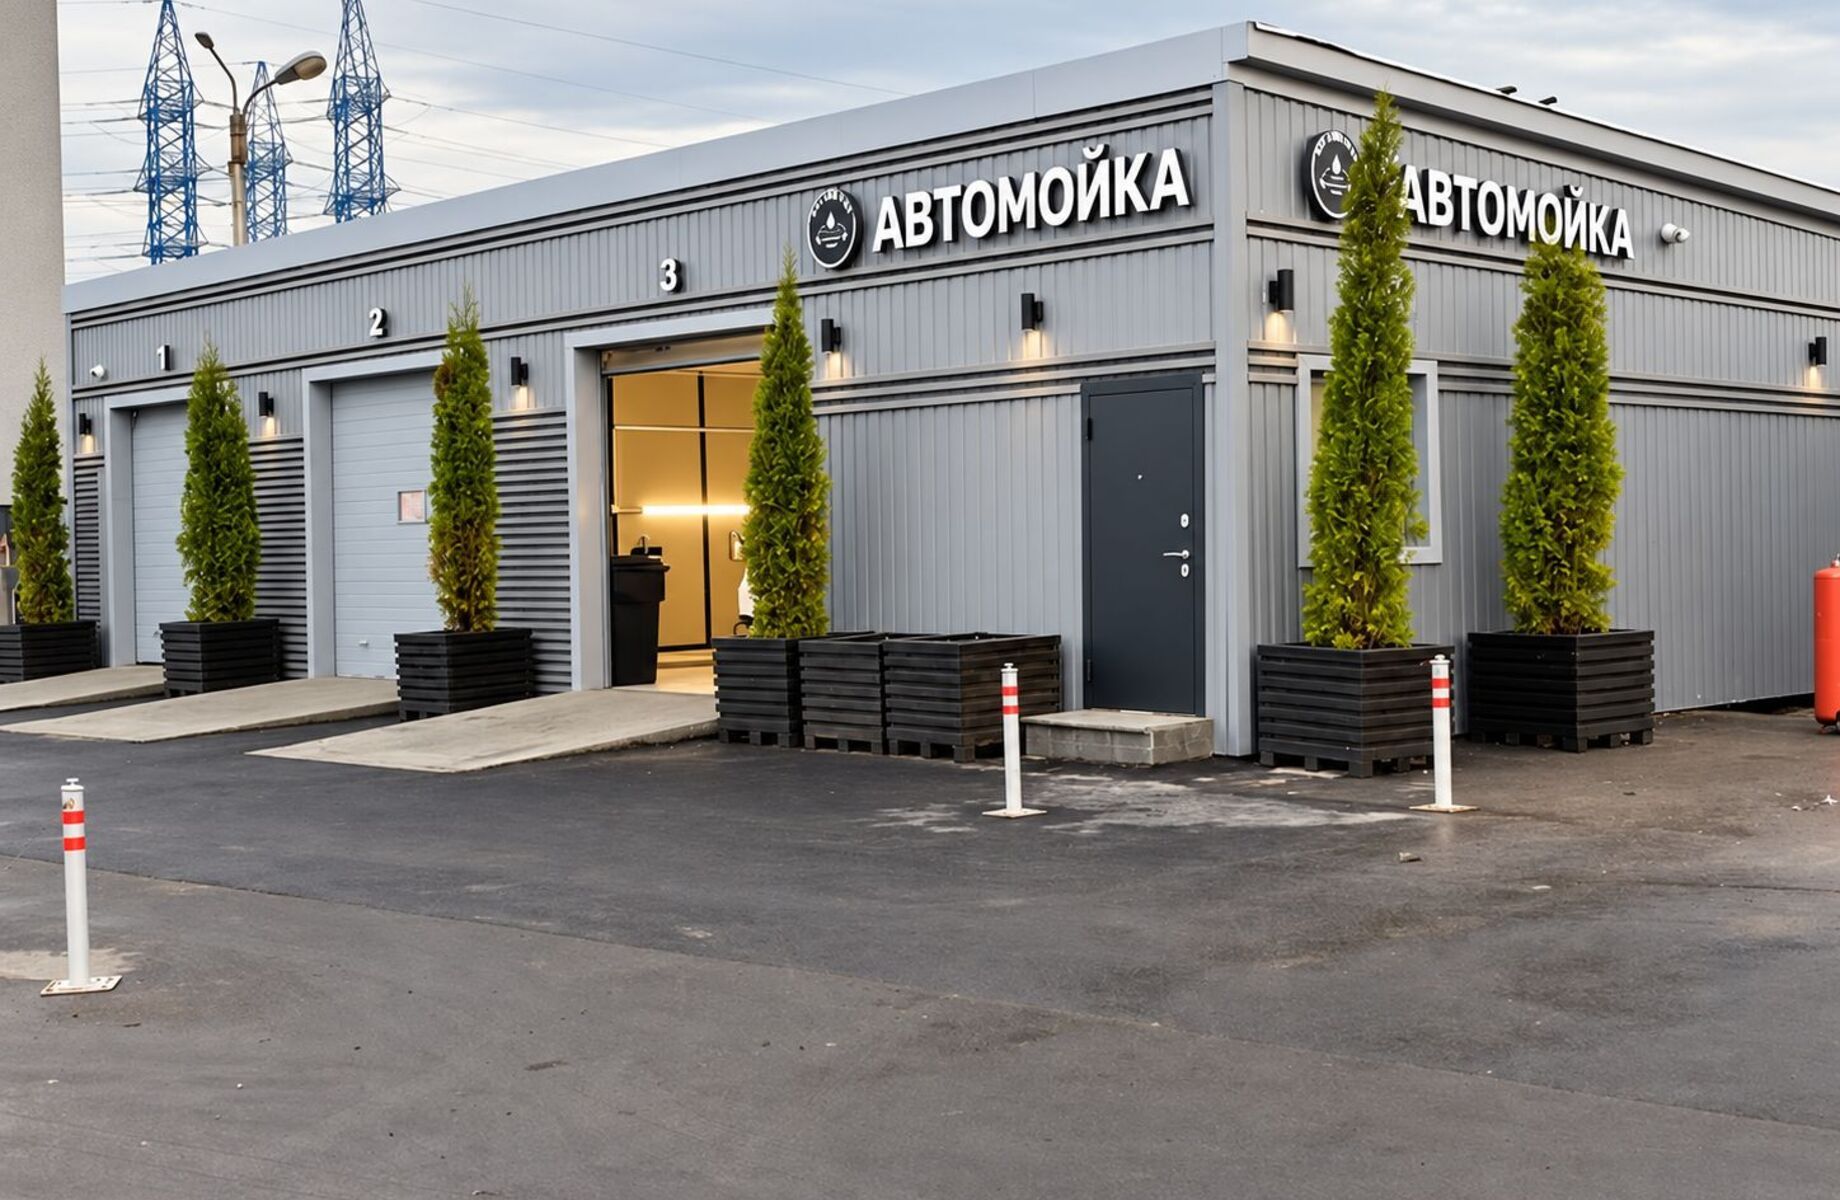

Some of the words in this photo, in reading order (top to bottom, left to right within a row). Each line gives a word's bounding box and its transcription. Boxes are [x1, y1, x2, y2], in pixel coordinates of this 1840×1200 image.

[872, 143, 1190, 252] АВТОМОЙКА
[1397, 164, 1635, 260] АВТОМОЙКА
[660, 258, 677, 291] 3
[369, 307, 383, 336] 2
[156, 345, 165, 370] 1
